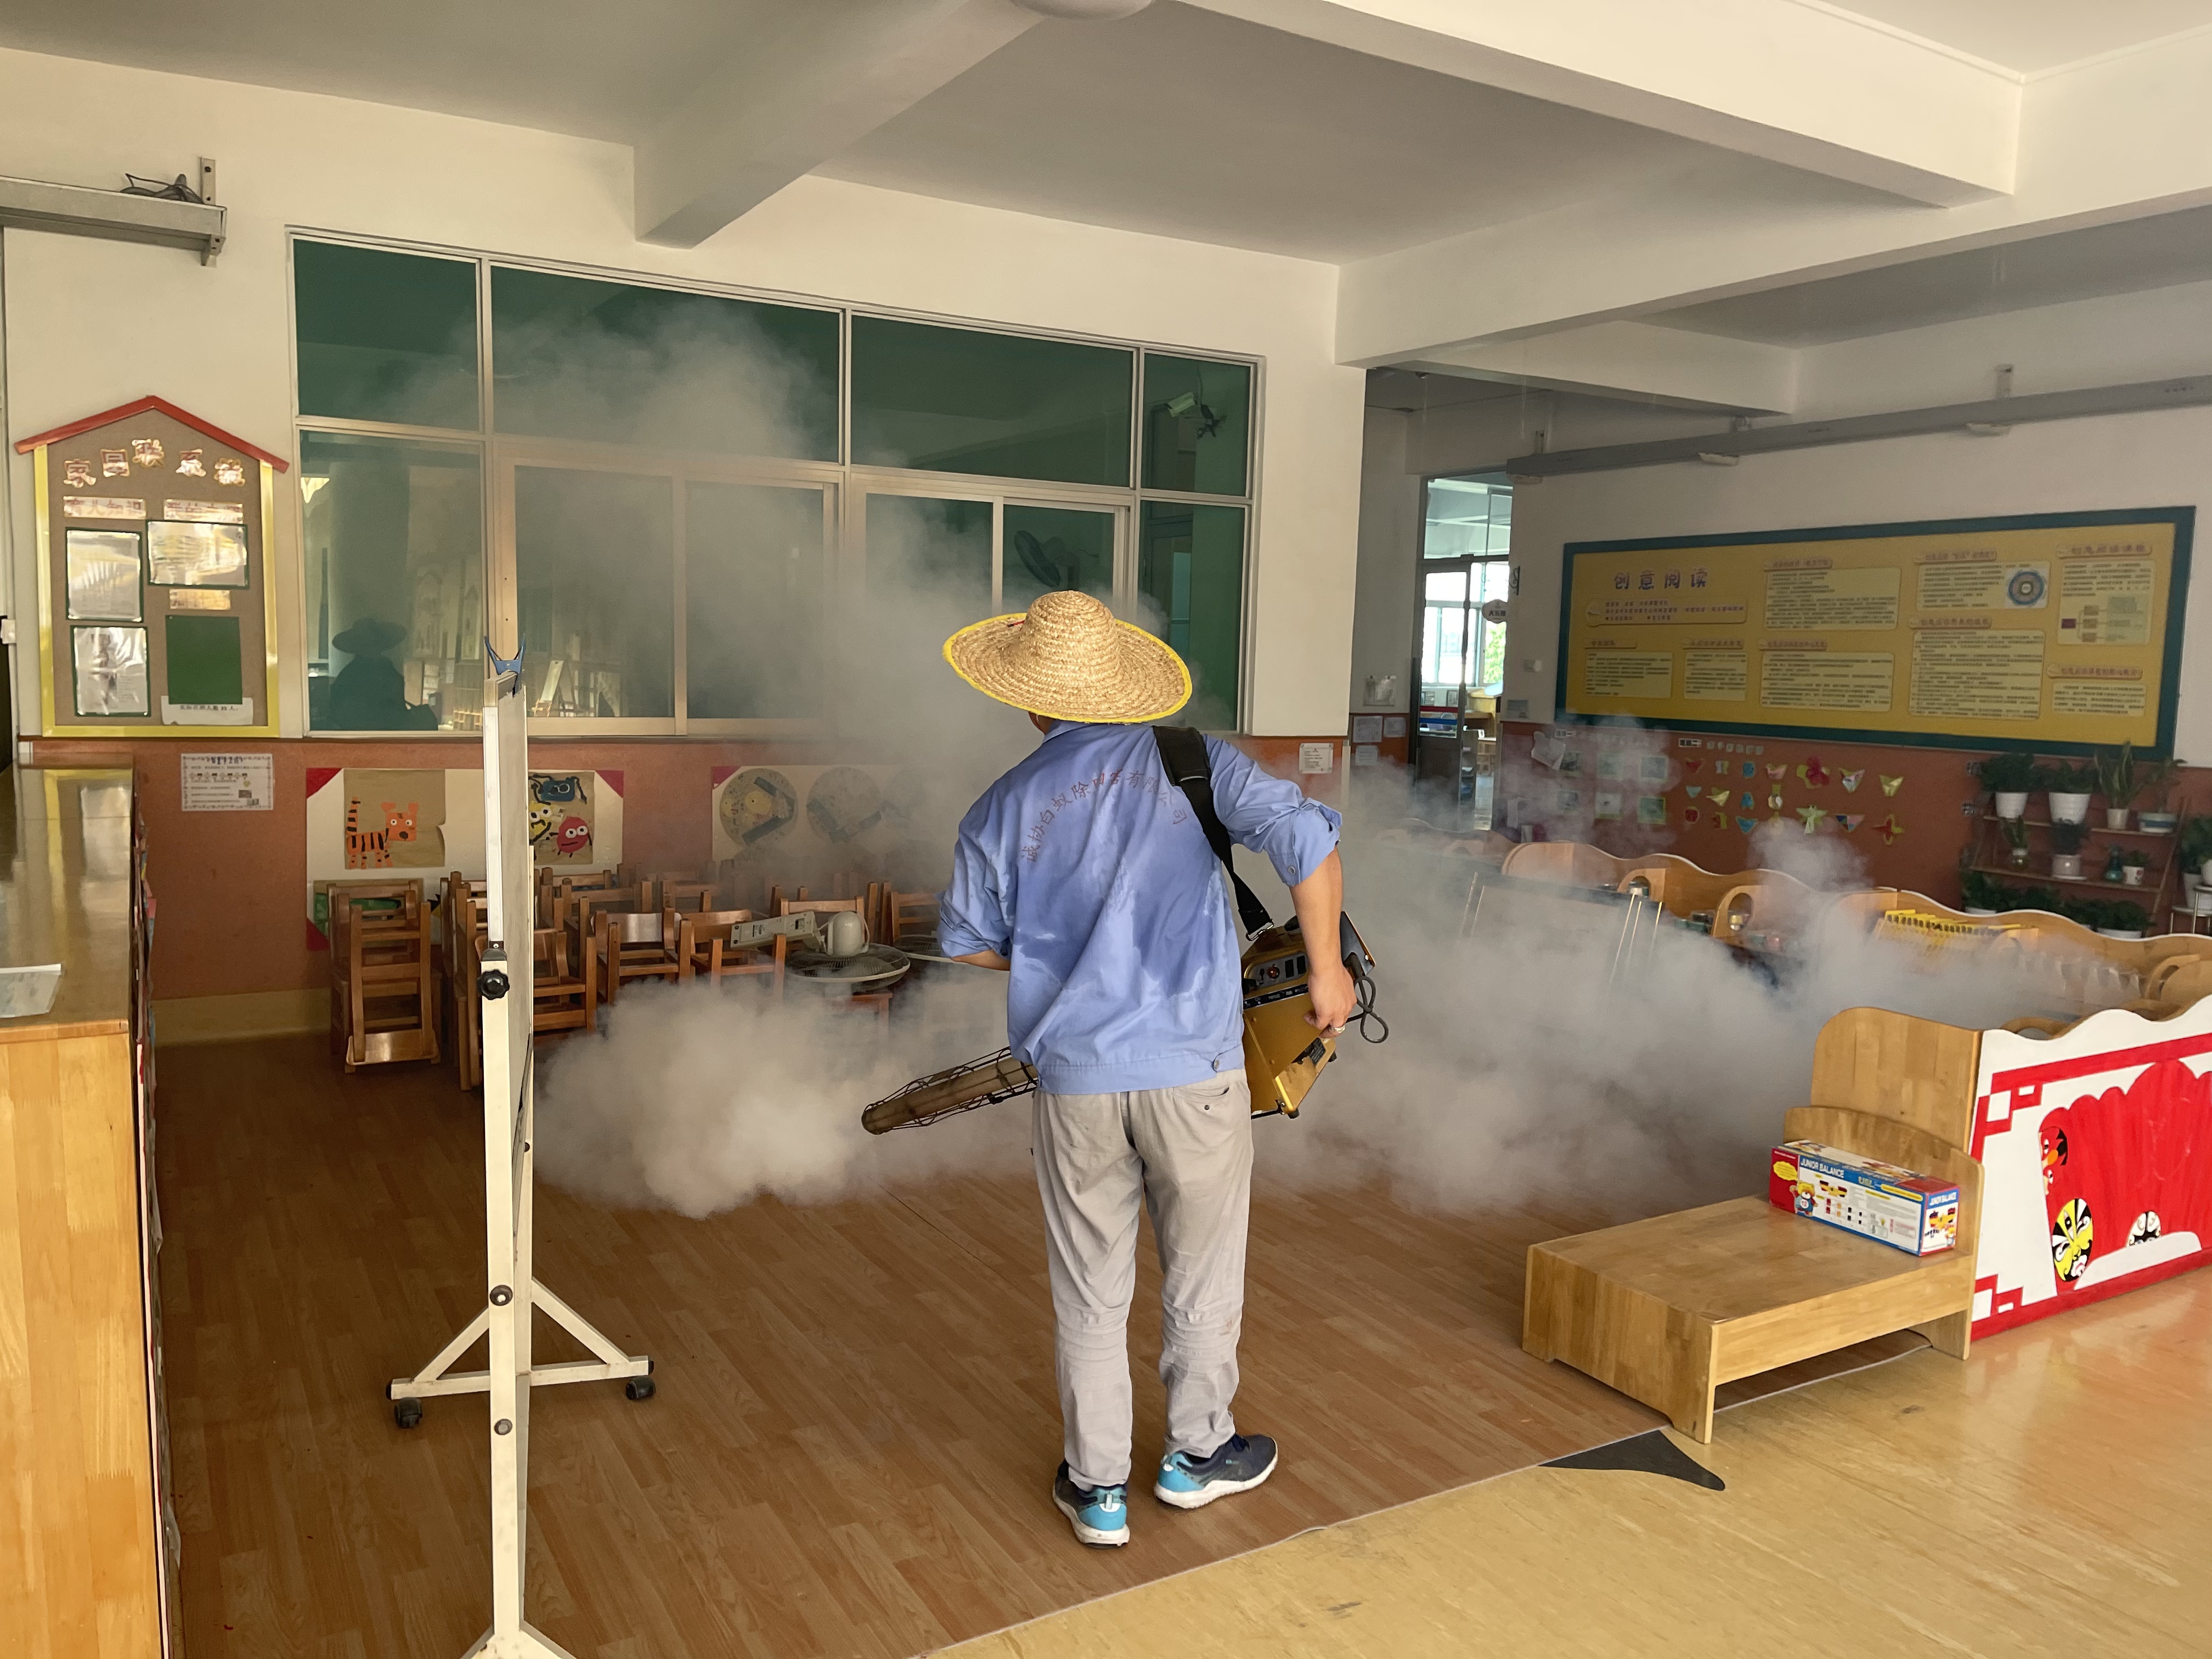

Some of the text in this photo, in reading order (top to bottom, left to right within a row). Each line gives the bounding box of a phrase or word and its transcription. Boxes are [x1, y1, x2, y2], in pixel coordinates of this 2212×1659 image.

[1615, 567, 1708, 590] 创意阅读
[1819, 1163, 1844, 1179] BALANCE
